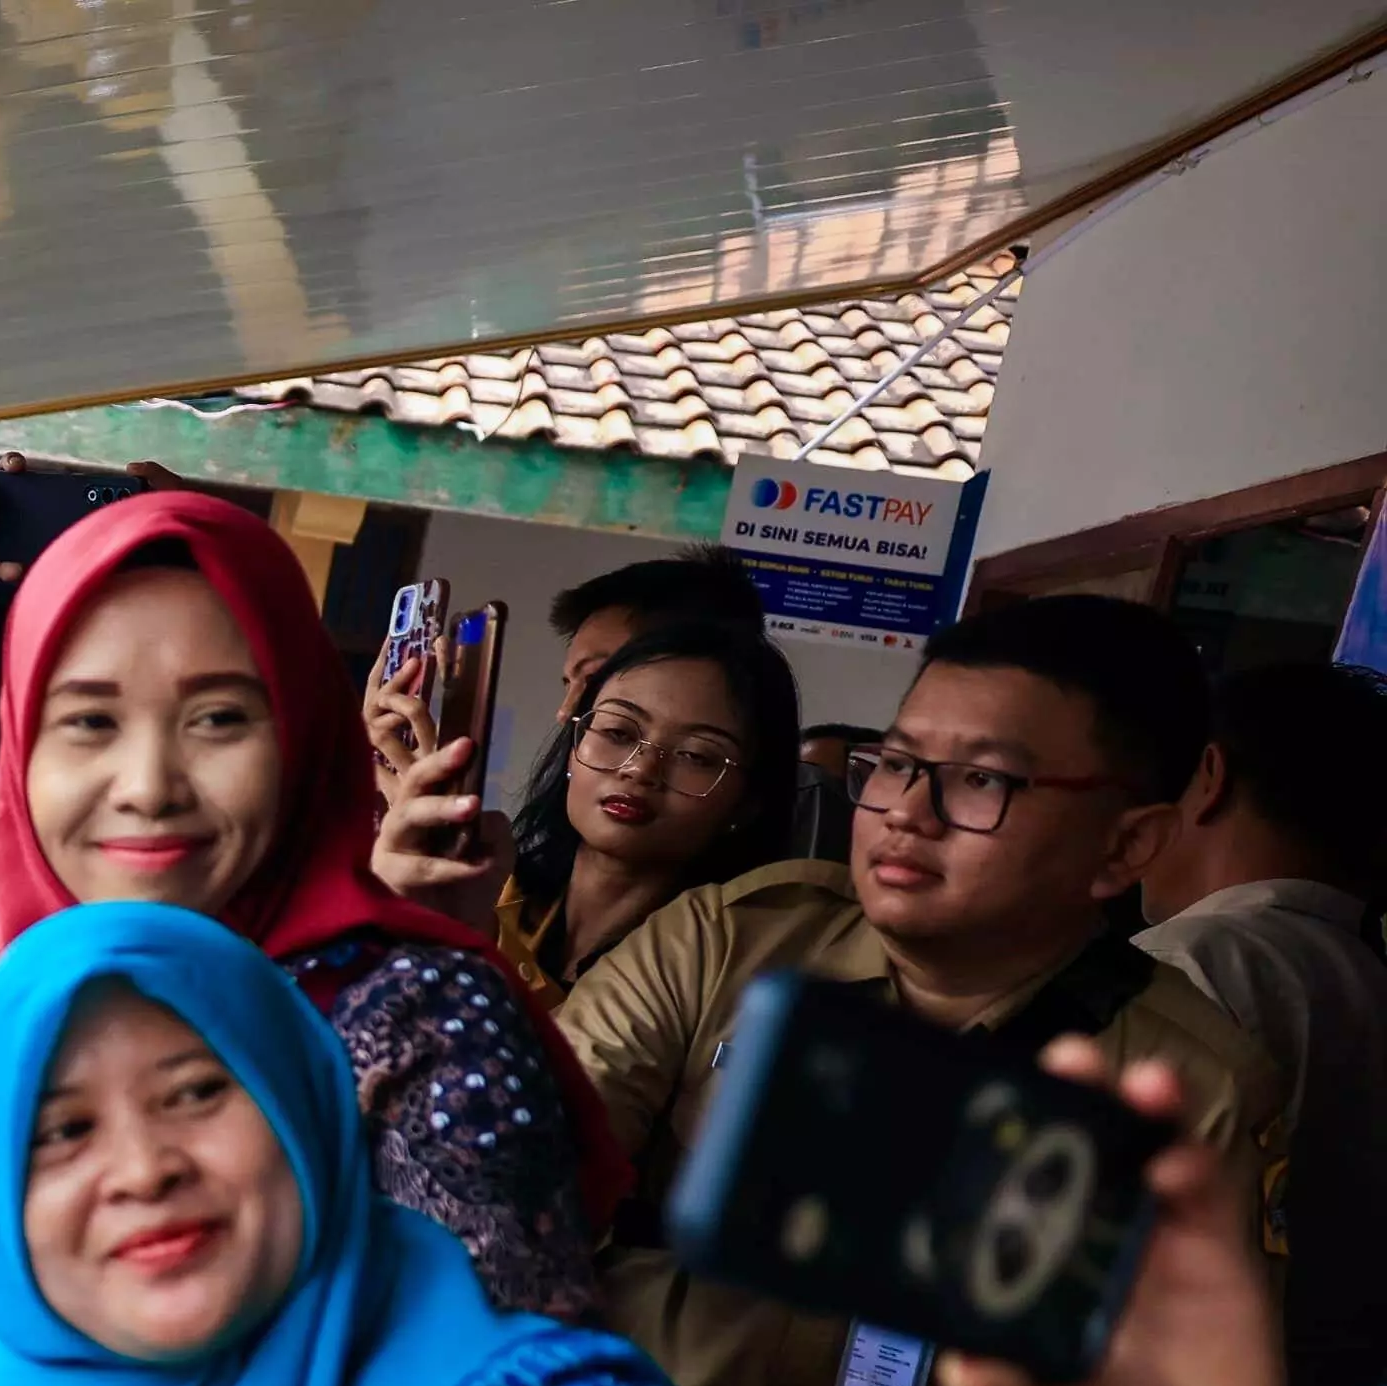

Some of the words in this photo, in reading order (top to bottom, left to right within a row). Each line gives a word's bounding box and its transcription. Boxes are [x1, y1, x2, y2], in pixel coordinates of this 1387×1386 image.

[804, 487, 934, 526] FASTPAY
[735, 522, 756, 537] DI
[760, 525, 799, 543] SINI
[803, 531, 870, 553] SEMUA
[875, 540, 928, 560] BISA!
